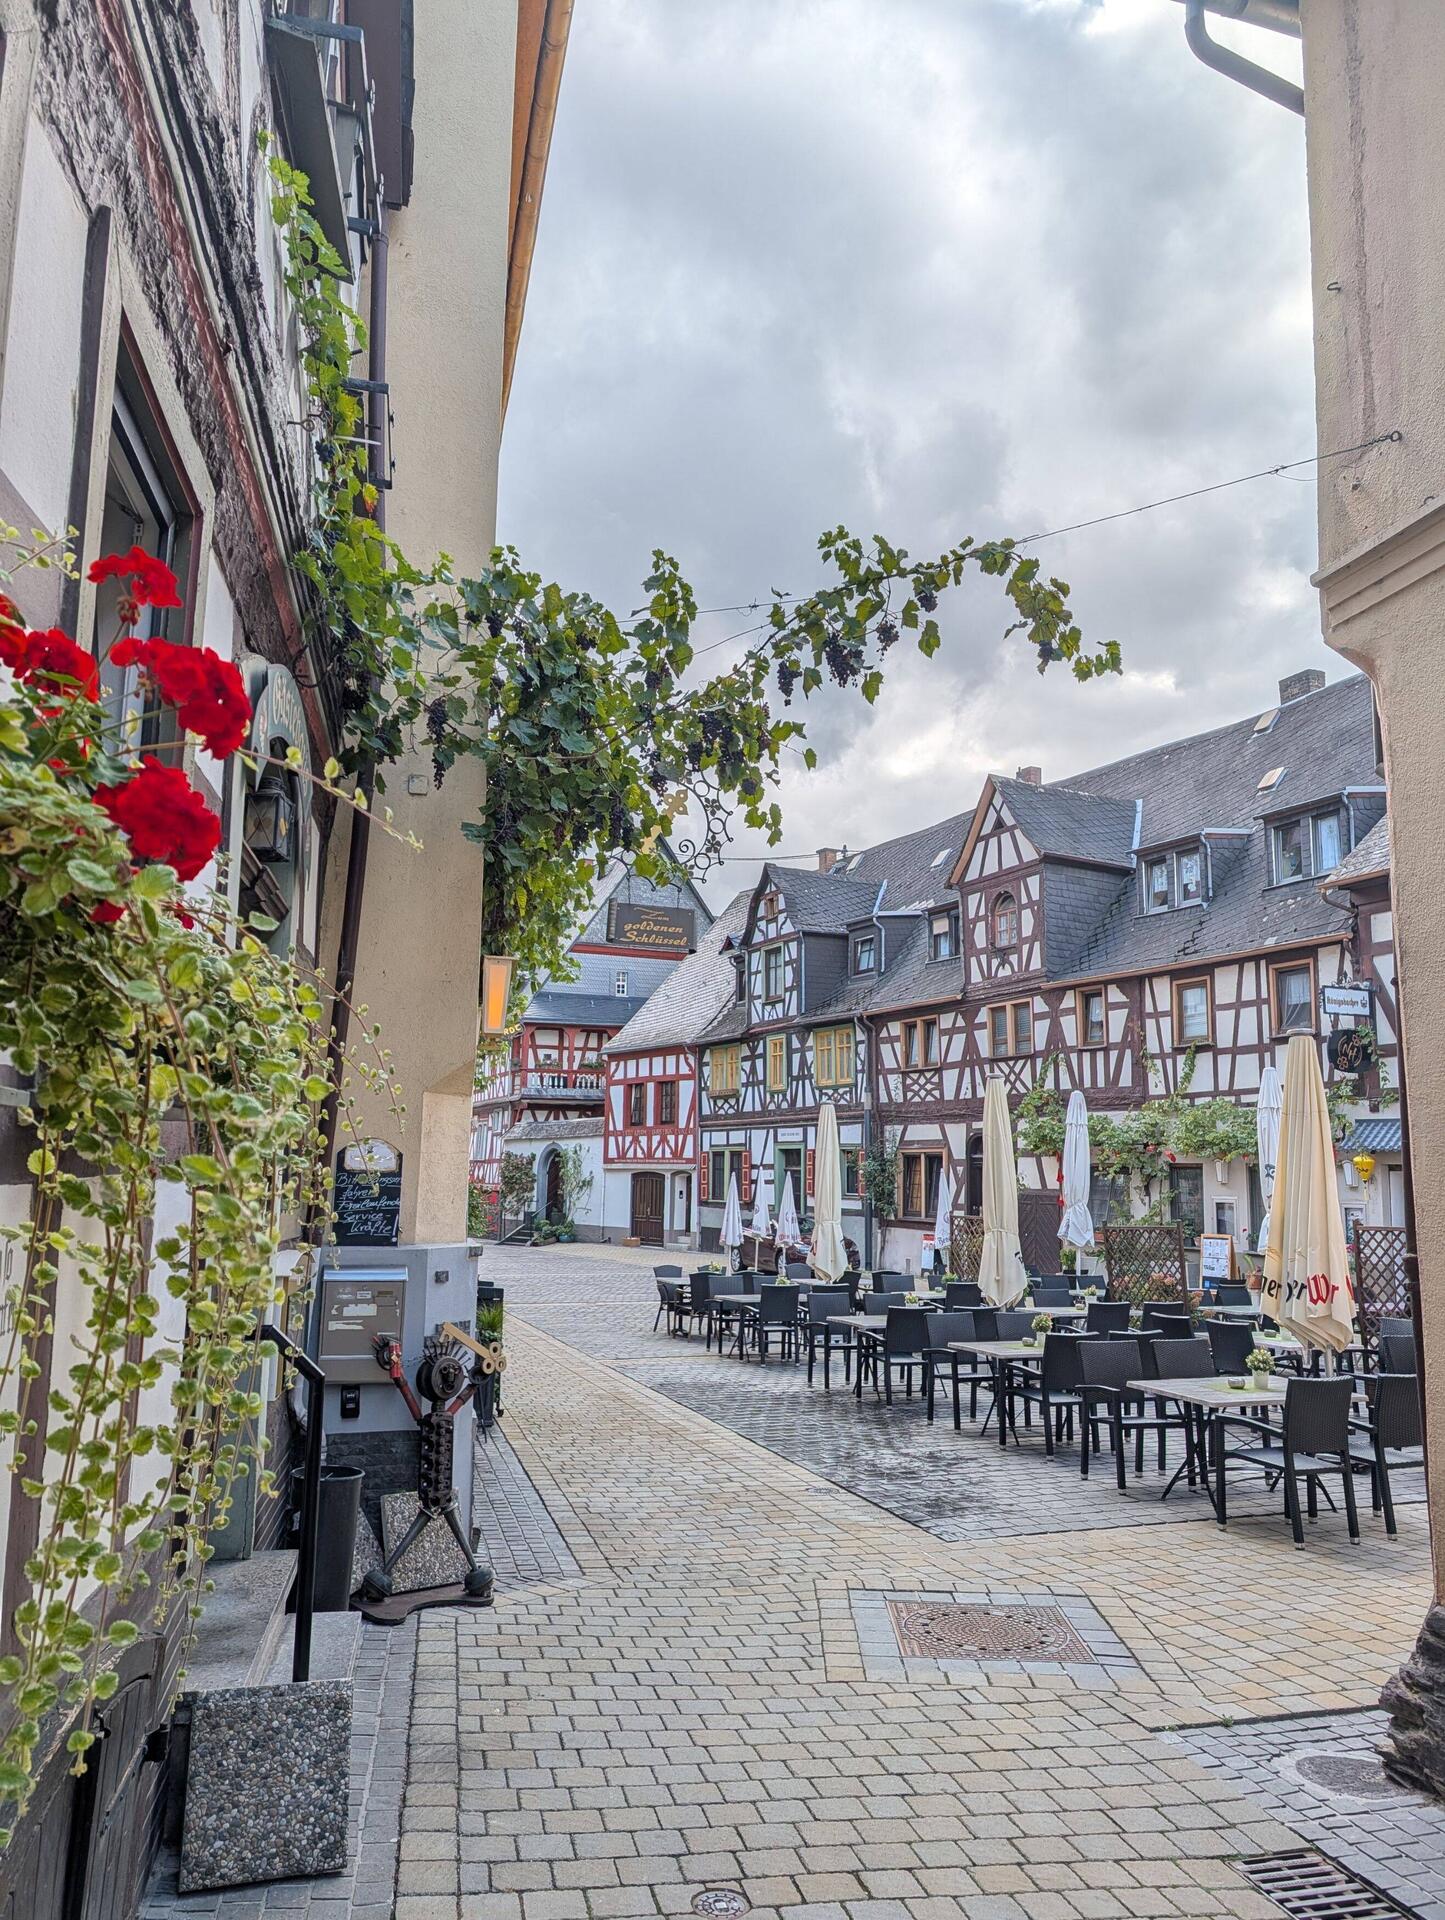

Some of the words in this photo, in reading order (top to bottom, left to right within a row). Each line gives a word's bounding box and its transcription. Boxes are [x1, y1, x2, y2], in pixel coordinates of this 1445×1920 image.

[633, 906, 670, 921] Zum
[623, 920, 683, 934] goldenen
[619, 930, 689, 946] Schlüssel
